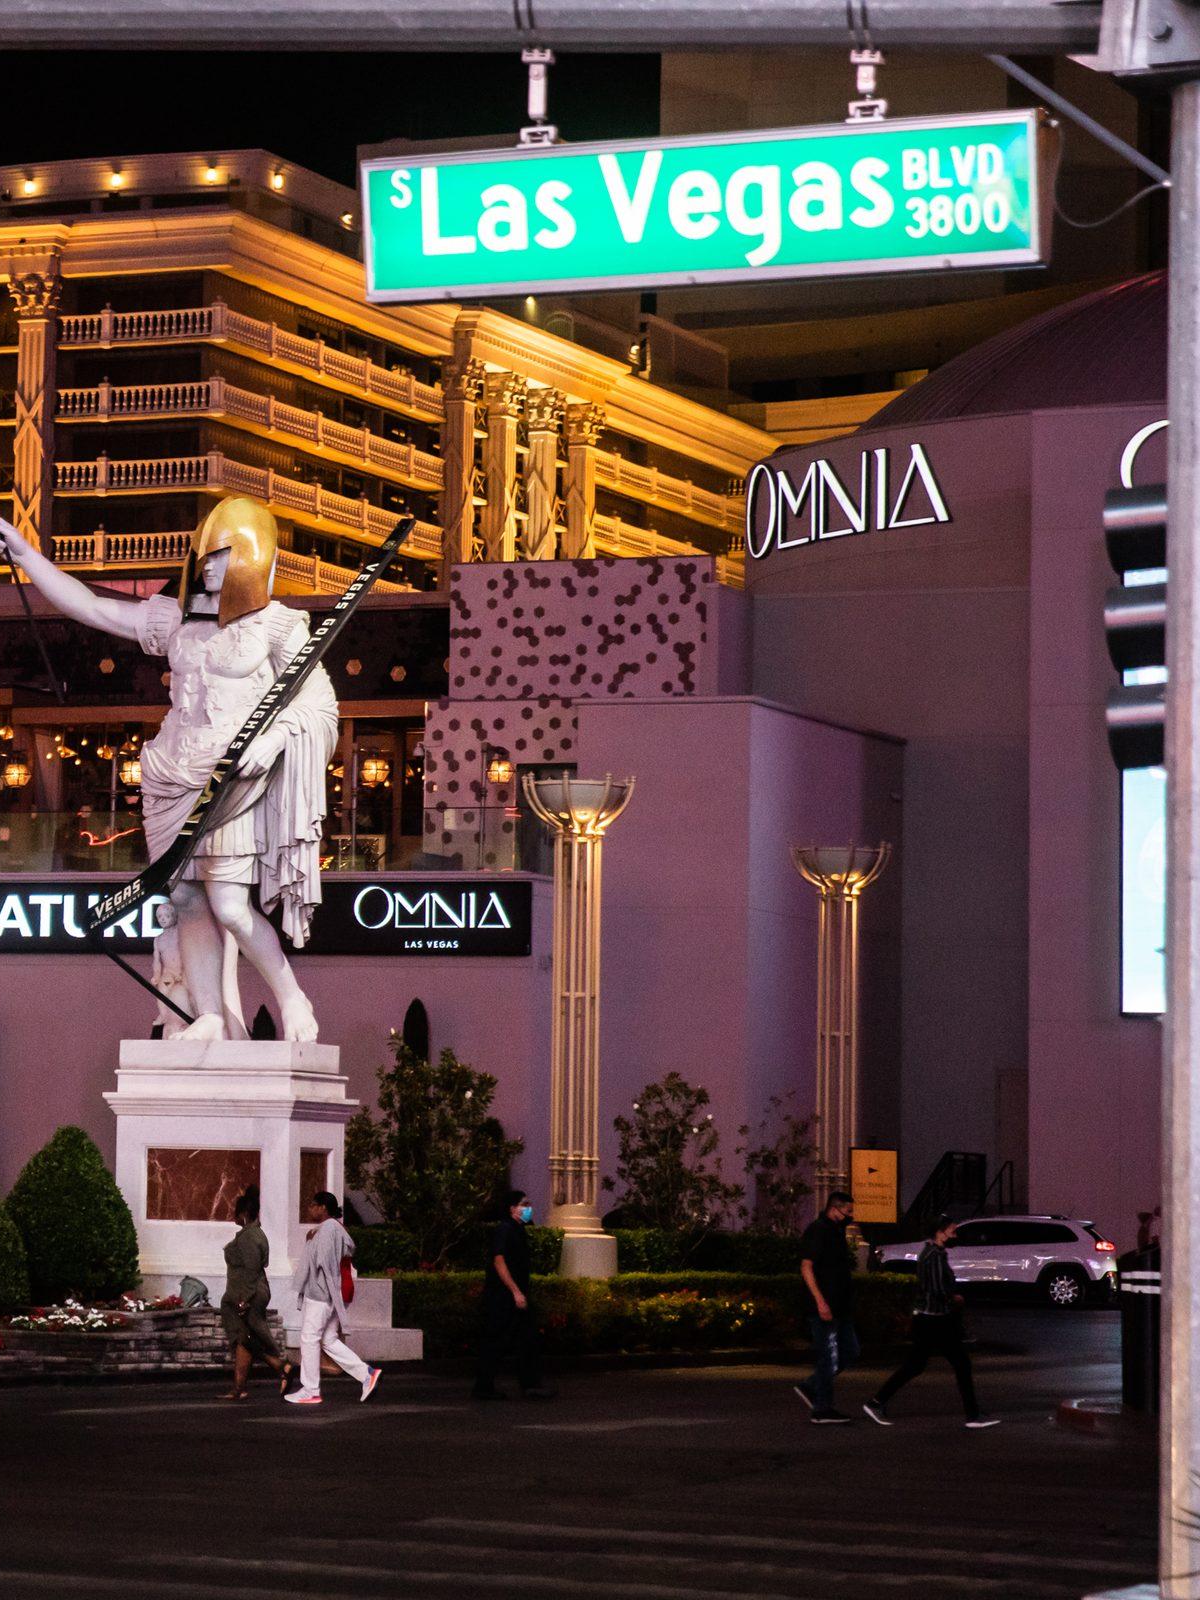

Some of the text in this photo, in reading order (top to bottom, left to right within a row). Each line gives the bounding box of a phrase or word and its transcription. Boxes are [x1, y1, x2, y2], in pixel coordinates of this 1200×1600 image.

[389, 142, 1002, 268] S Las Vegas BLVD
[904, 191, 1010, 240] 3800
[746, 443, 950, 559] OMNIA
[230, 562, 380, 749] VEGAS GOLDEN KNIGHTS
[94, 879, 141, 919] VEGAS
[353, 886, 511, 930] OMNIA
[404, 940, 459, 949] LAS VEGAS
